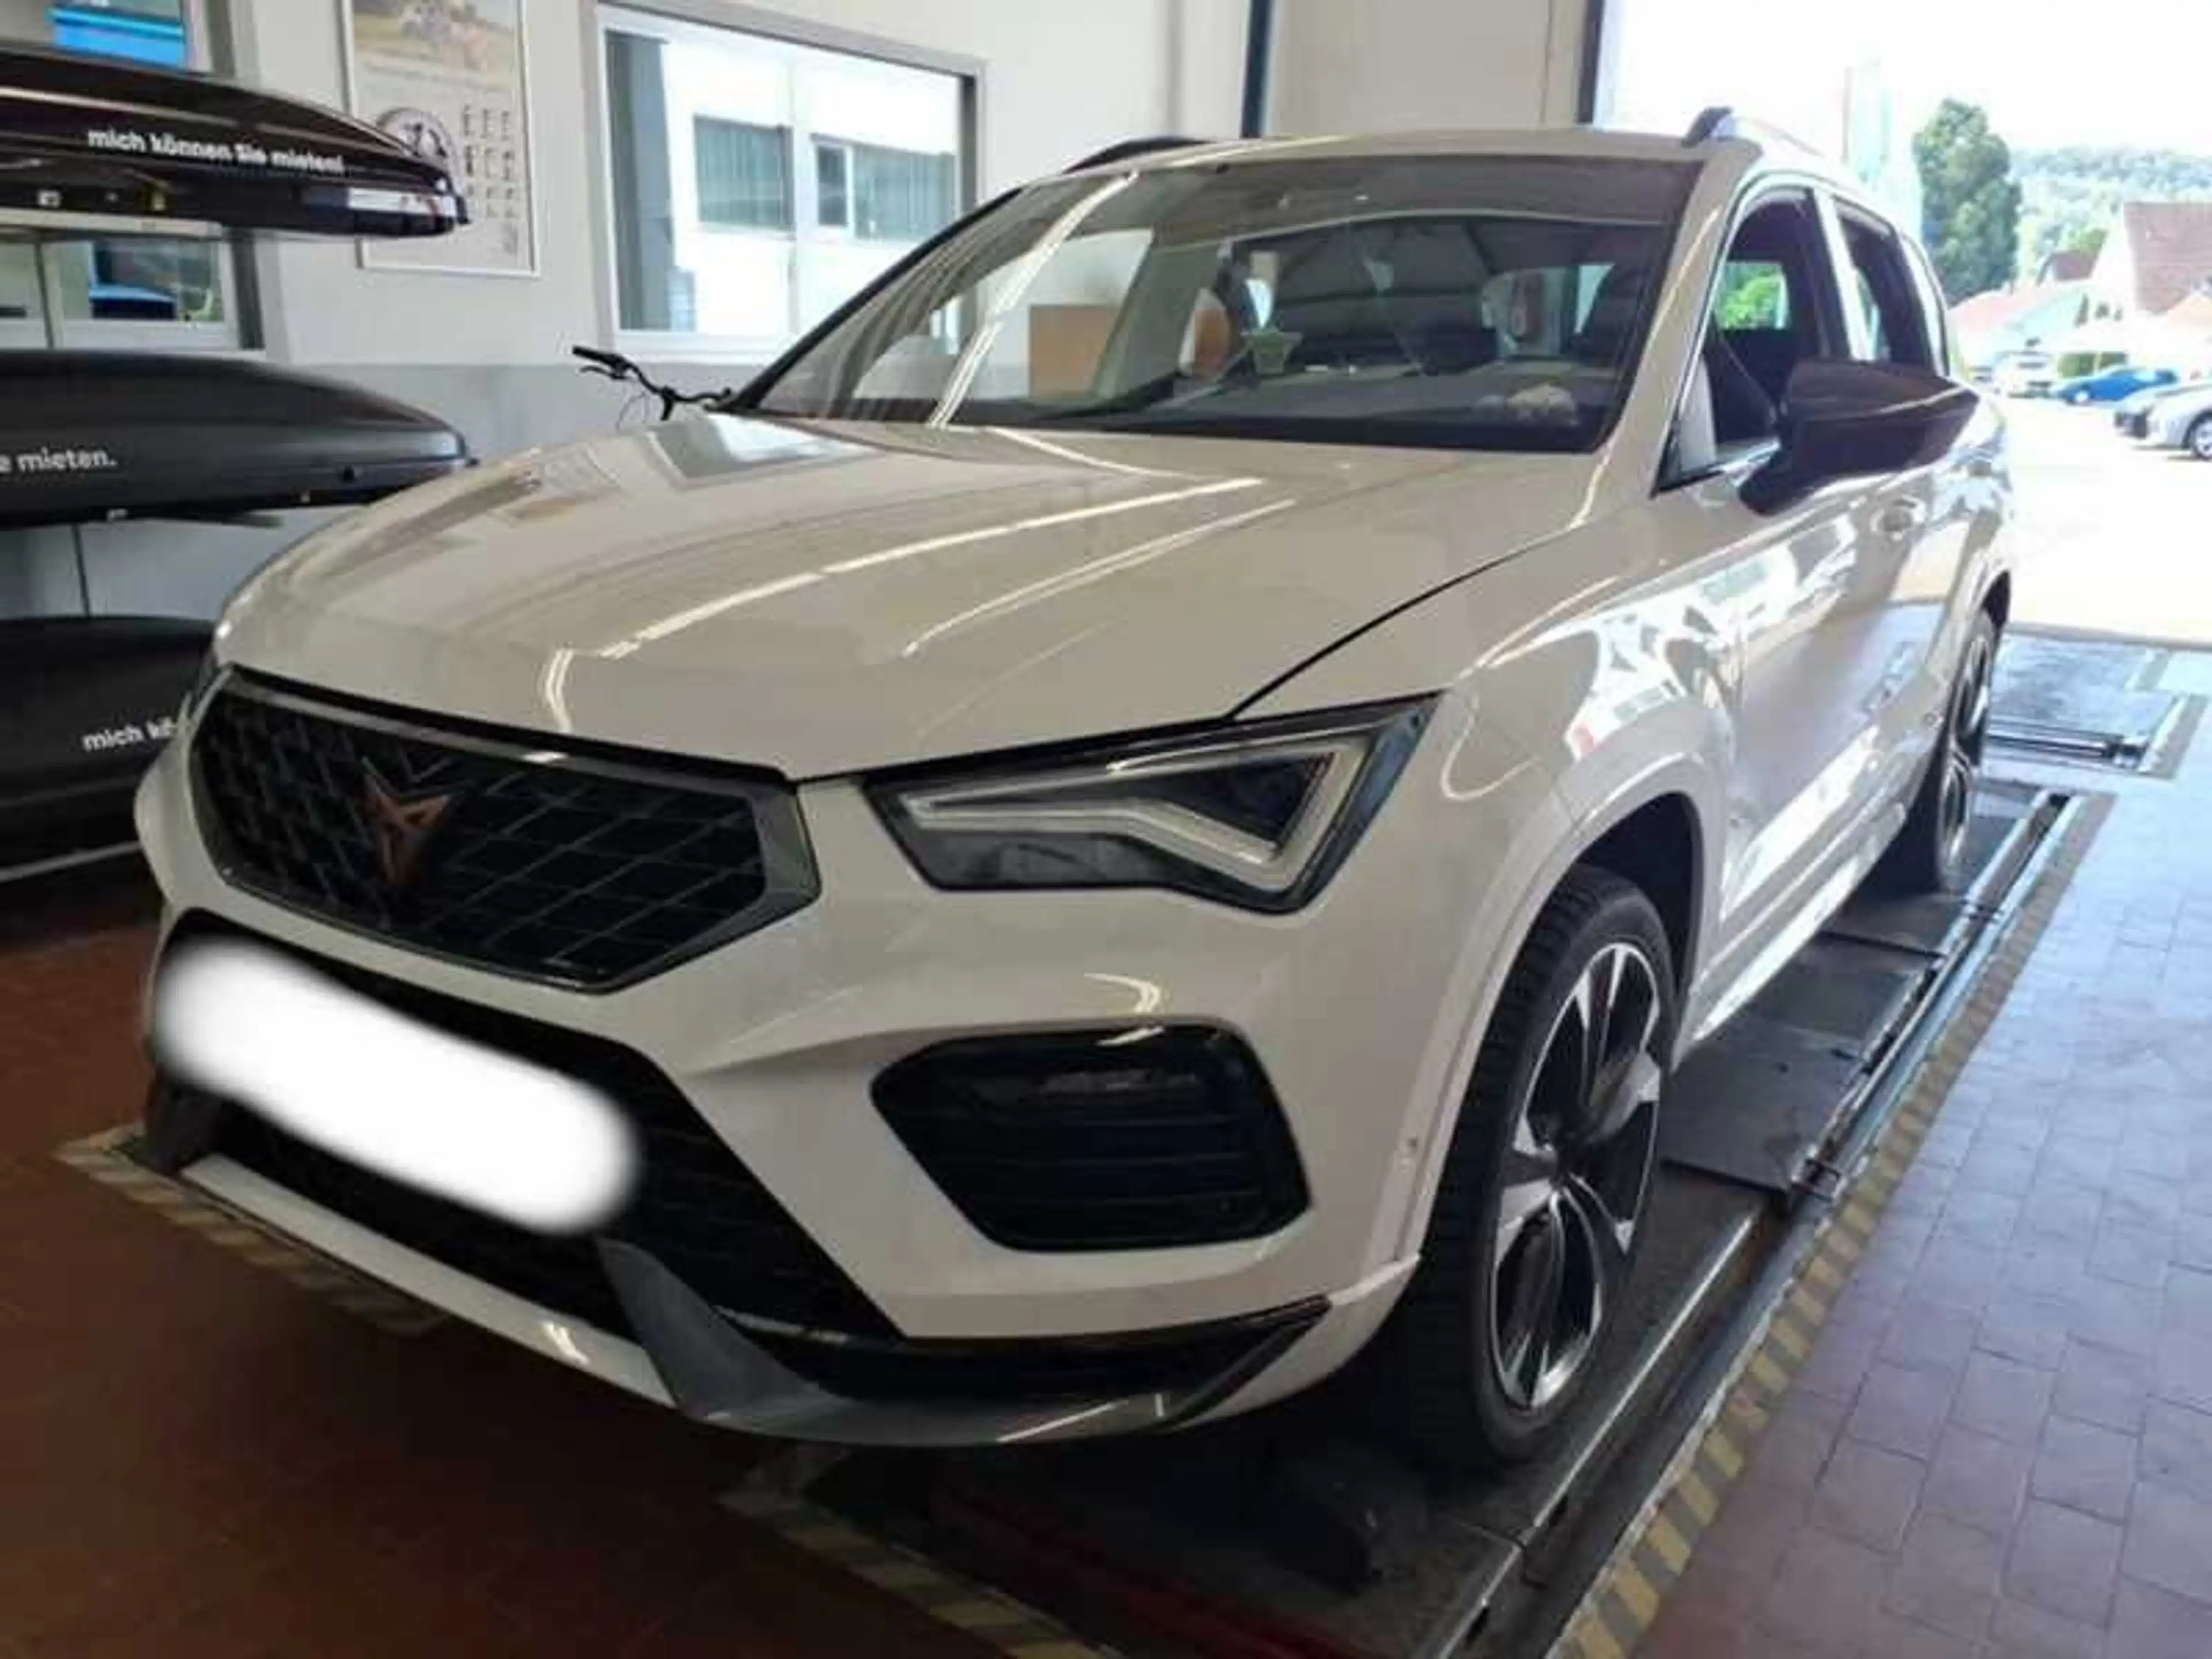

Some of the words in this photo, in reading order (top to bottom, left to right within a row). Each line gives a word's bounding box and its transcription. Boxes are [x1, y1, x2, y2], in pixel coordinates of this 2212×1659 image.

[88, 128, 145, 153] mich
[150, 132, 230, 161] können
[234, 143, 266, 165] Sie
[17, 446, 117, 473] mieten.
[83, 724, 143, 752] mich
